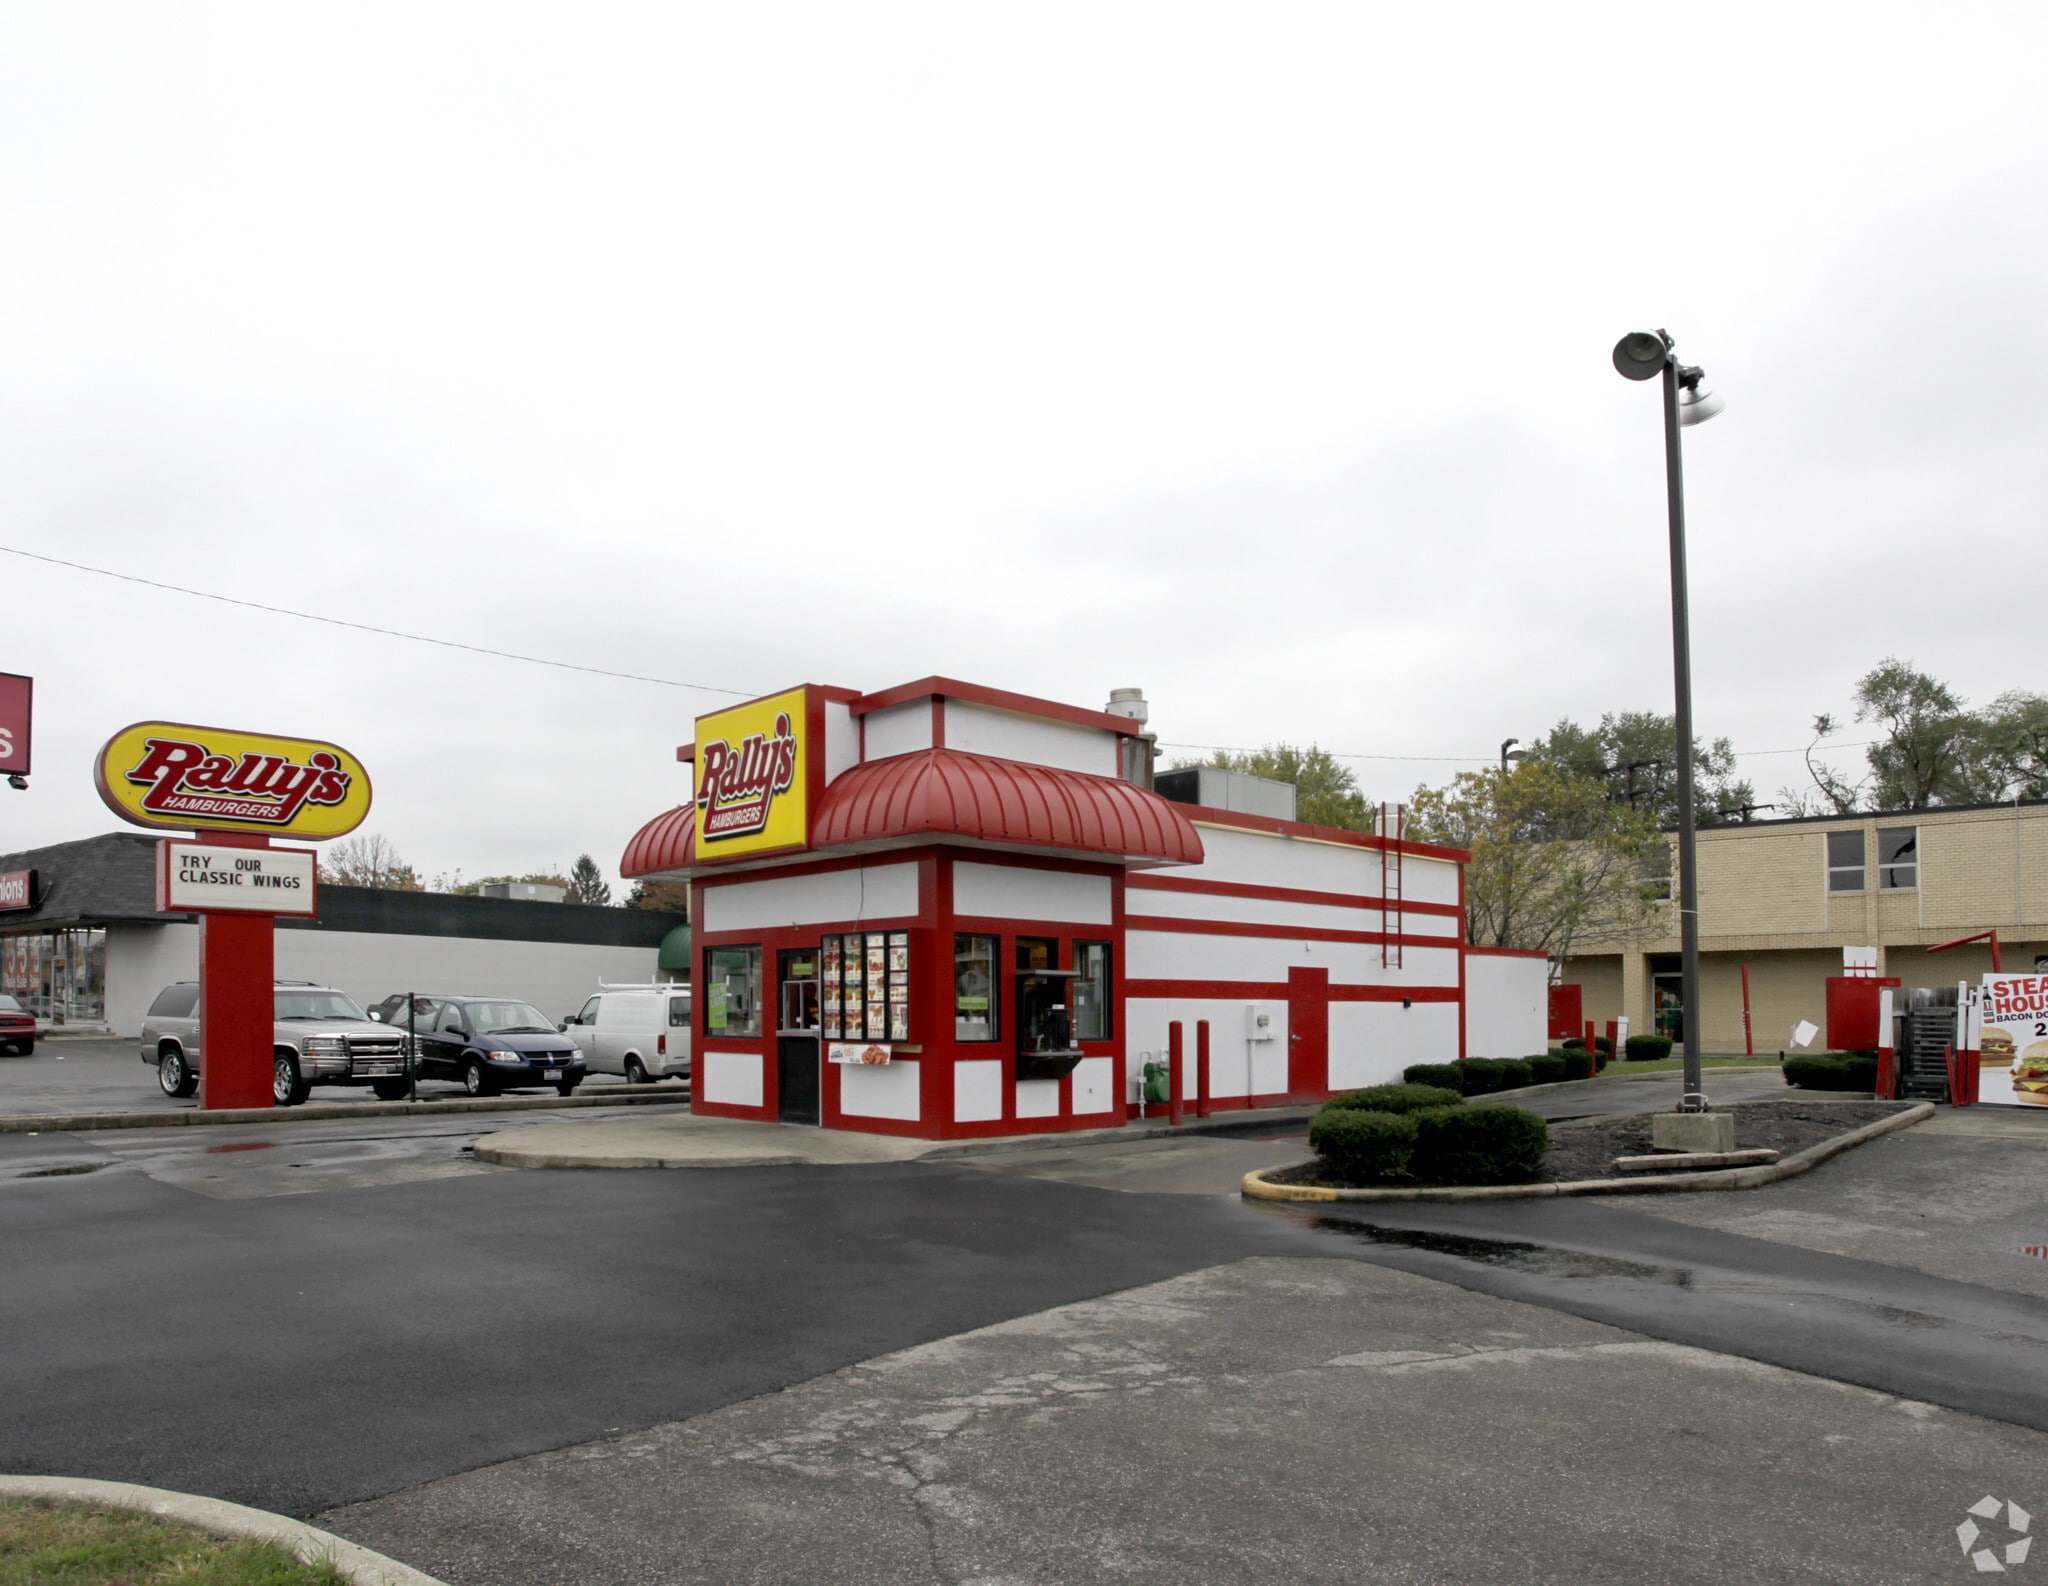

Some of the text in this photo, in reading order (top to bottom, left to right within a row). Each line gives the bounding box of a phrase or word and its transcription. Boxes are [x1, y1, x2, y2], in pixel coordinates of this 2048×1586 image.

[124, 737, 350, 823] Rally's
[698, 712, 796, 837] Rally's
[161, 796, 282, 818] HAMBURGERS
[709, 806, 763, 830] HAMBURGERS
[181, 855, 262, 873] TRY OUR
[179, 869, 301, 889] CLASSIC WINGS
[1995, 995, 2048, 1014] HOU
[1996, 1012, 2032, 1022] BACON
